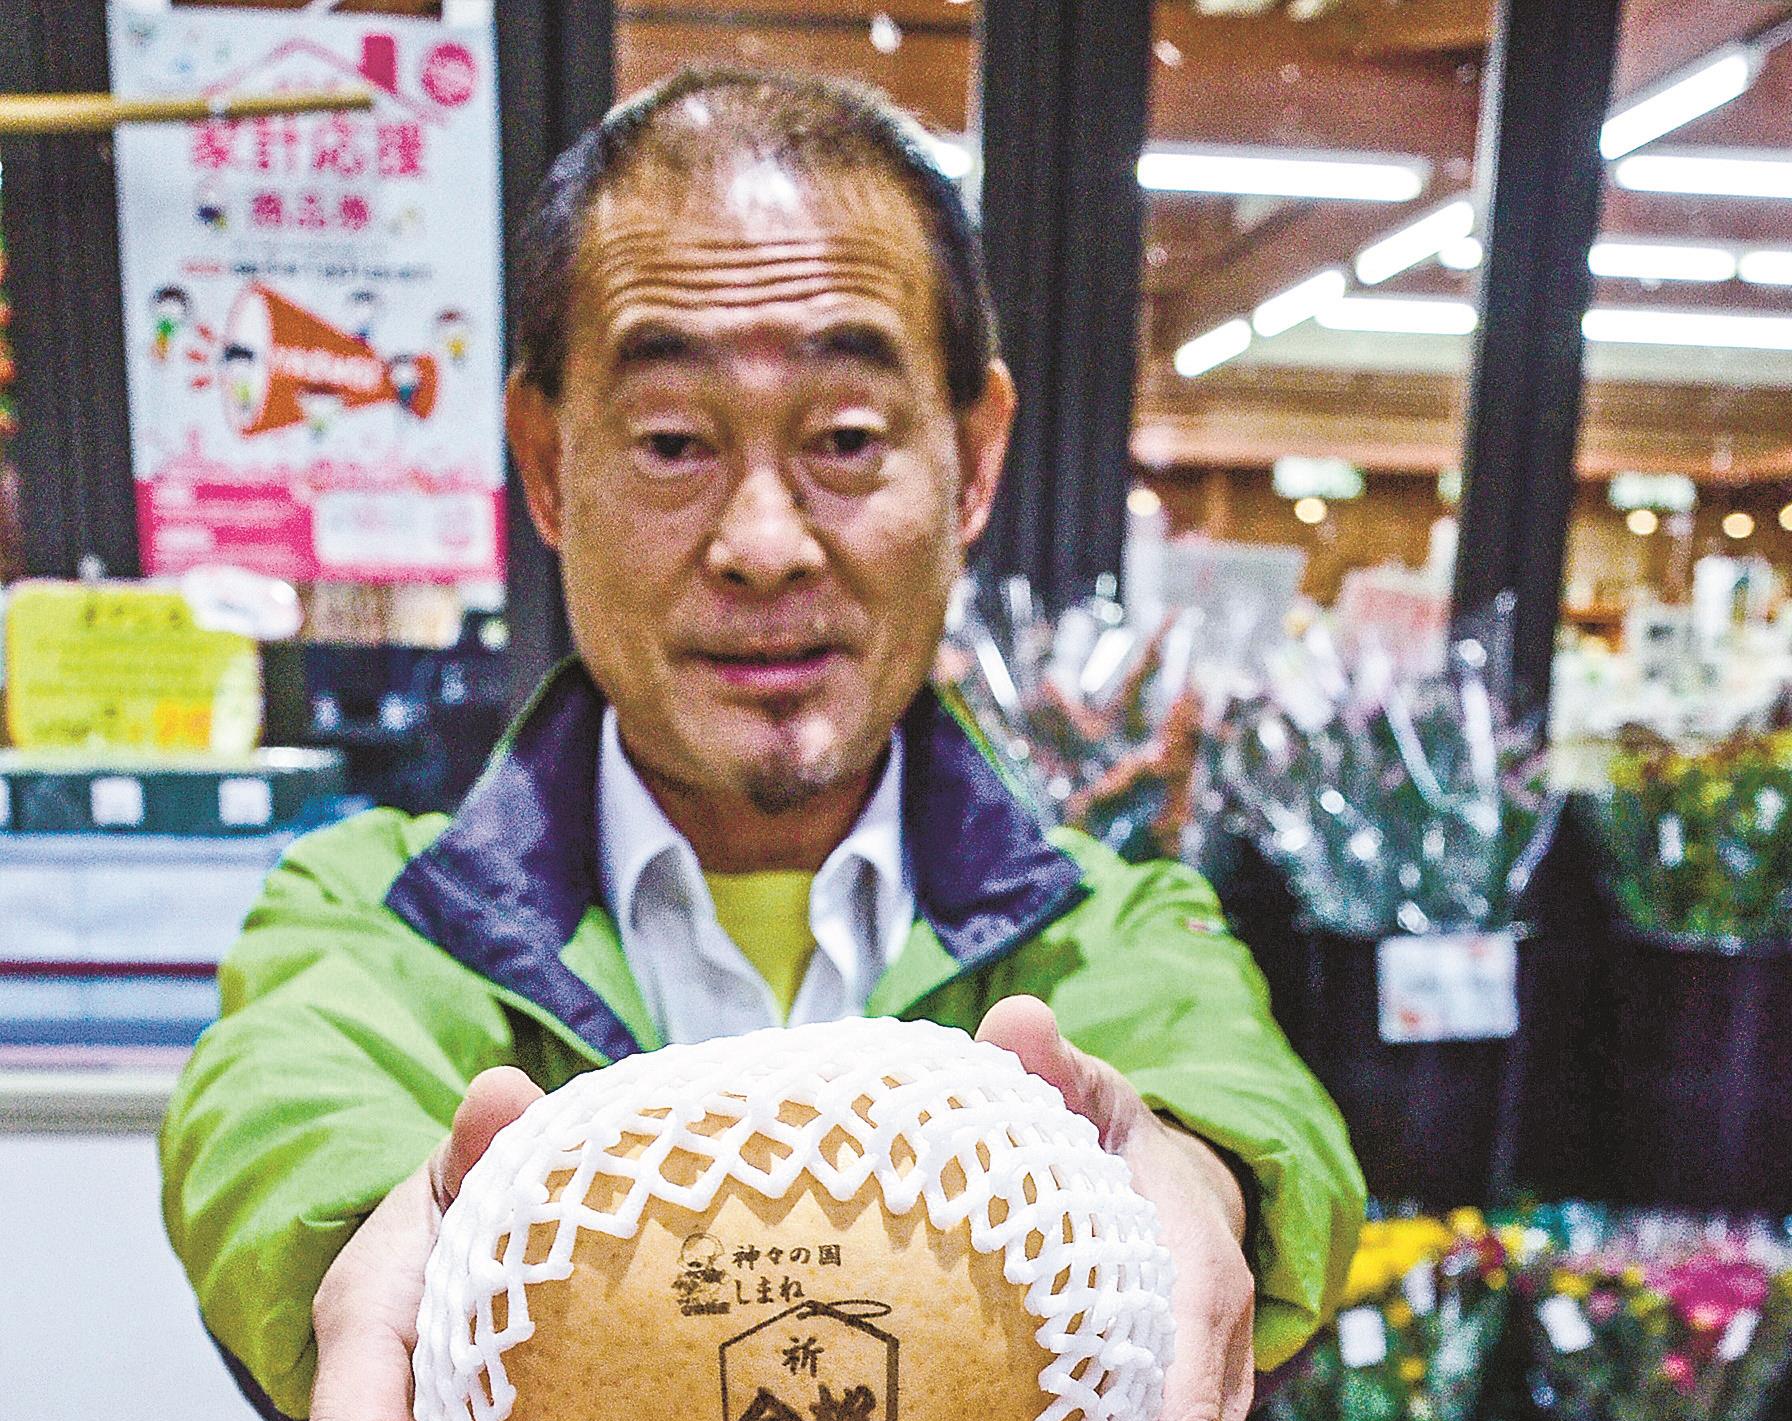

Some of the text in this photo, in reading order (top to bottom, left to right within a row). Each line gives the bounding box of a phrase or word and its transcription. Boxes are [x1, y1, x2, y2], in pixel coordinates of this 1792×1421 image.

[732, 1244, 841, 1270] 神々の国
[734, 1275, 805, 1304] しまね
[782, 1336, 824, 1377] 祈
